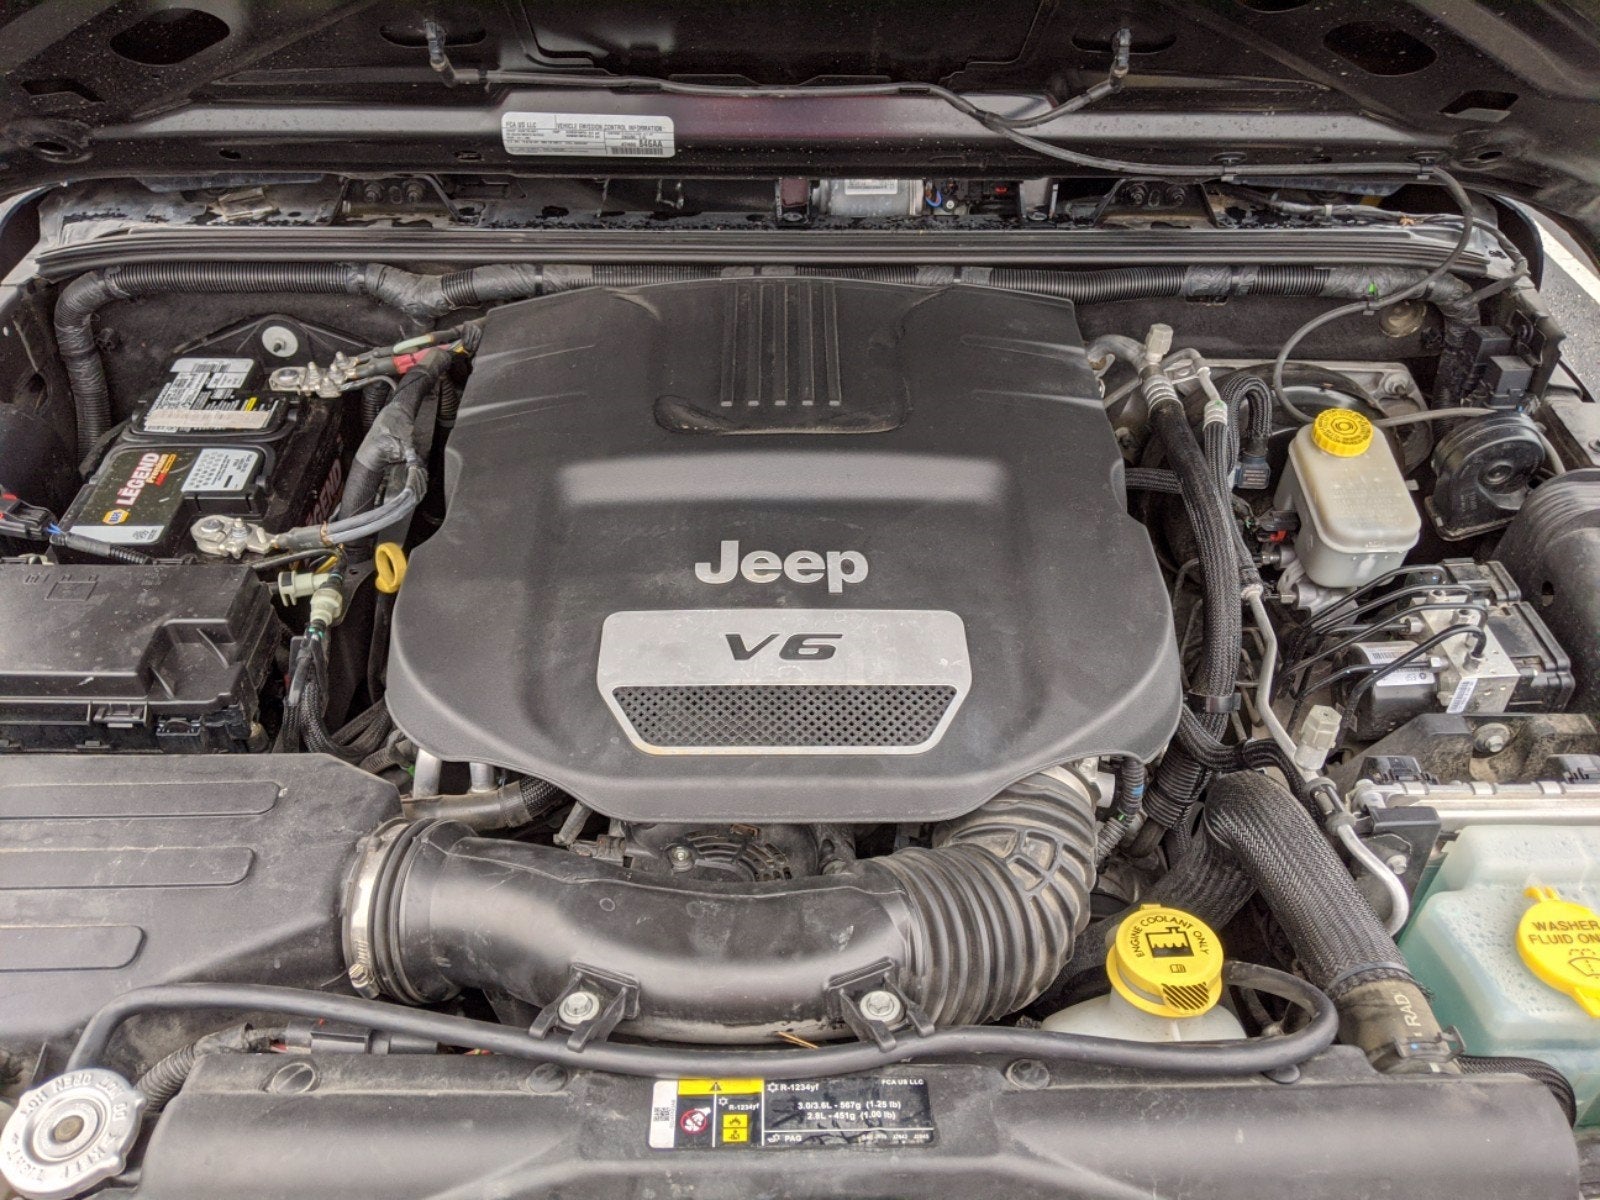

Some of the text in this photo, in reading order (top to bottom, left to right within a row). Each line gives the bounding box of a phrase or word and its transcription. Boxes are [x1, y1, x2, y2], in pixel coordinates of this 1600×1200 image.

[694, 540, 869, 594] Jeep
[724, 633, 843, 661] V6
[1531, 920, 1600, 932] WASHER
[1130, 915, 1210, 958] ENGINE COOLANT ONLY
[1528, 933, 1574, 945] FLUID
[1394, 994, 1422, 1028] RAD
[780, 1083, 820, 1093] R-1234yf
[728, 1102, 760, 1111] R-1234yf
[889, 1100, 902, 1110] lb)
[833, 1111, 856, 1121] 451g
[883, 1111, 896, 1121] lb)
